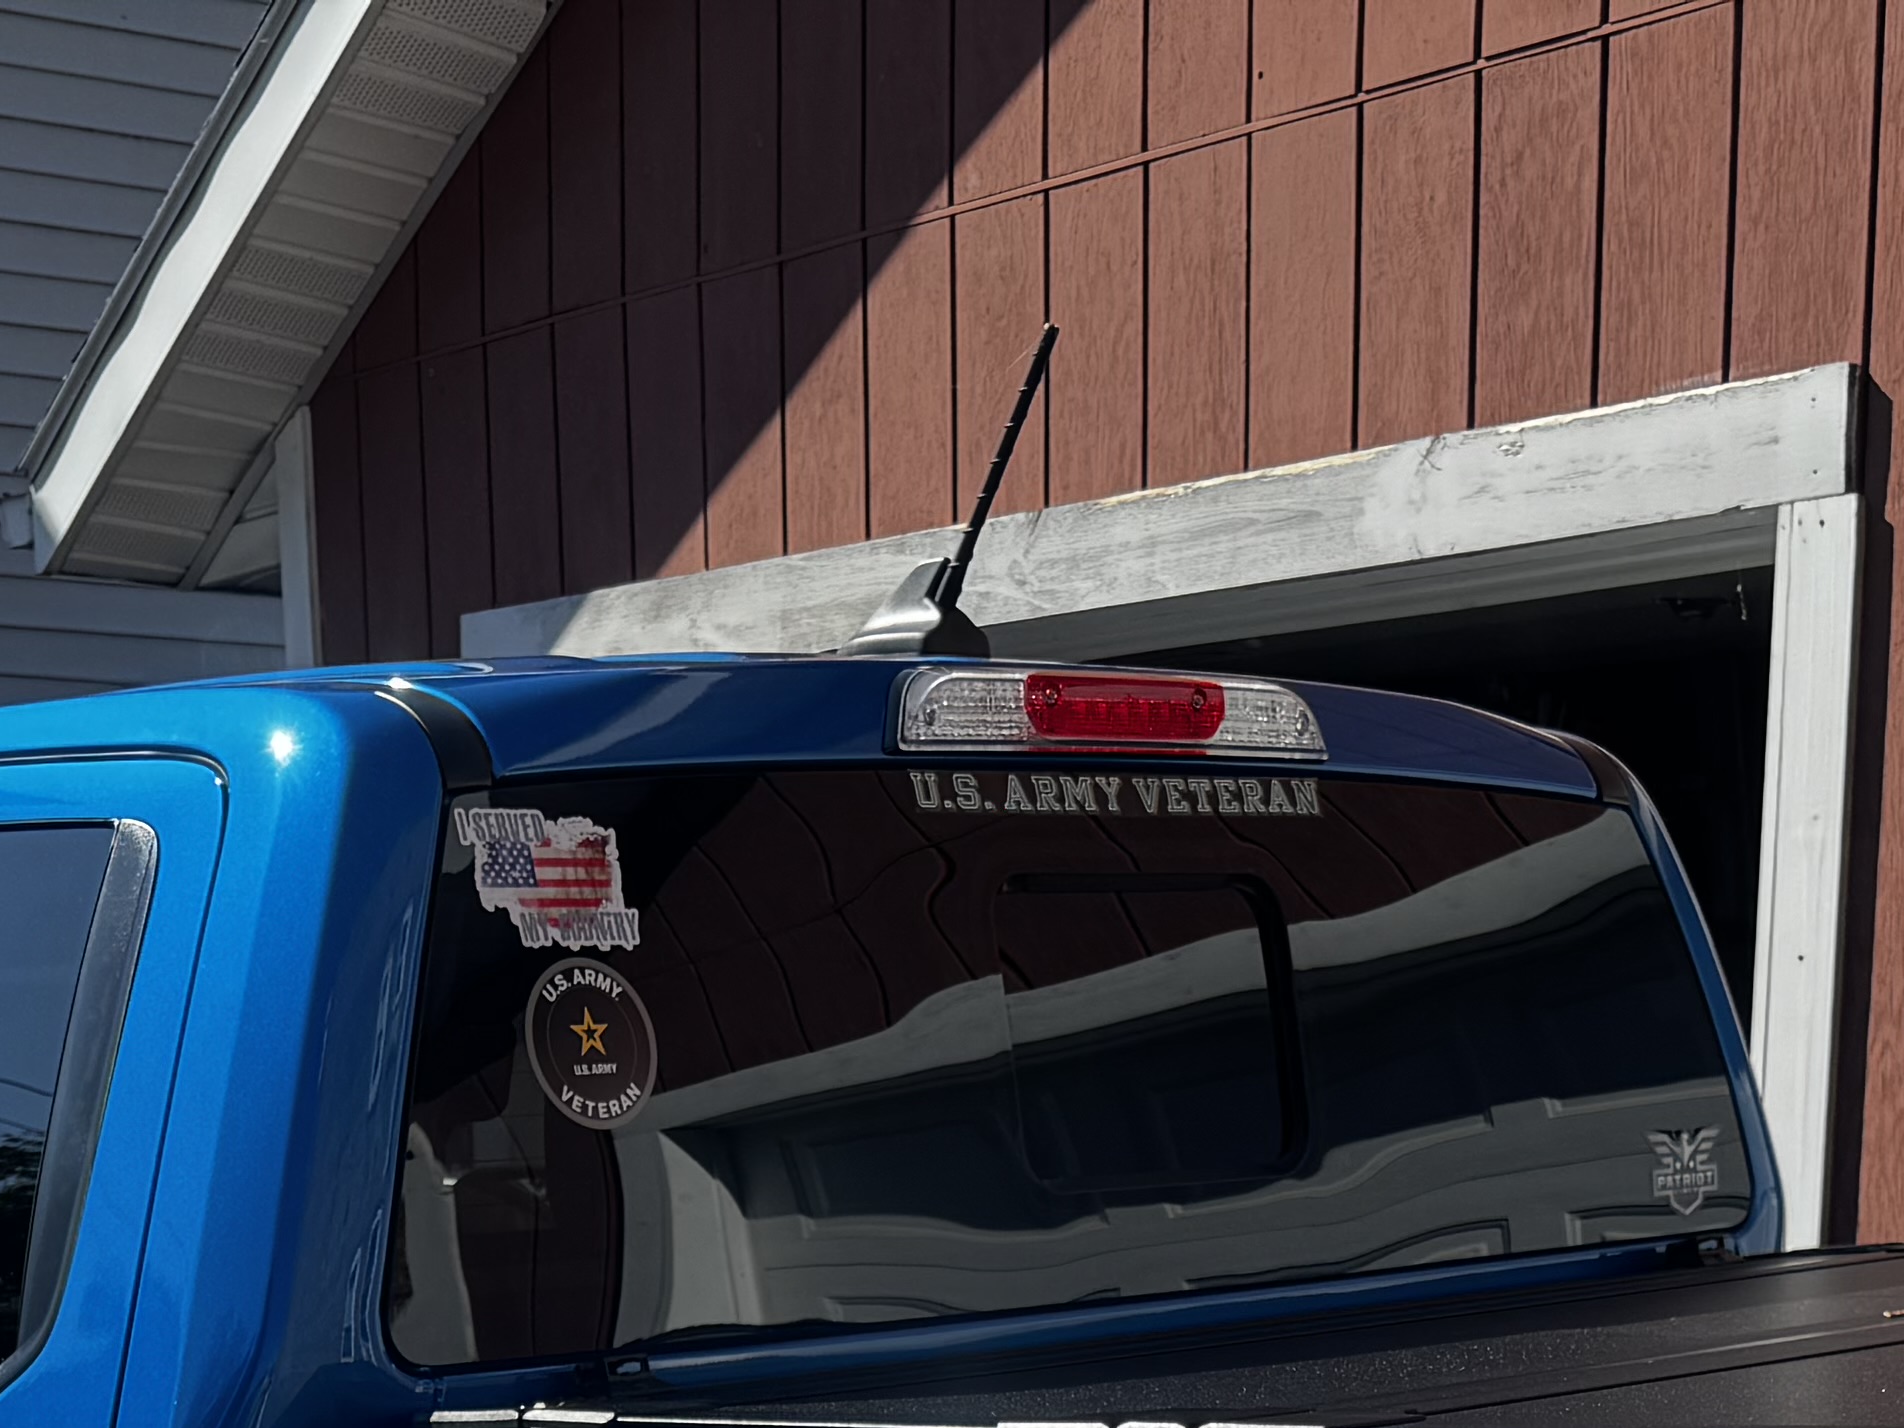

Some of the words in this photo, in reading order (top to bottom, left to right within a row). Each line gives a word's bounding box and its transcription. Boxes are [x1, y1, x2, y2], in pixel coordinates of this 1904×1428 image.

[909, 770, 994, 811] U.S.
[1004, 772, 1123, 814] ARMY
[1132, 776, 1323, 817] VETERAN
[456, 810, 468, 842] I
[471, 810, 546, 843] SERVED
[519, 911, 549, 944] MY
[541, 973, 572, 1003] U.S.
[591, 1062, 618, 1075] ARMY
[560, 1081, 642, 1119] VETERAN
[1657, 1170, 1713, 1190] PATRIOT
